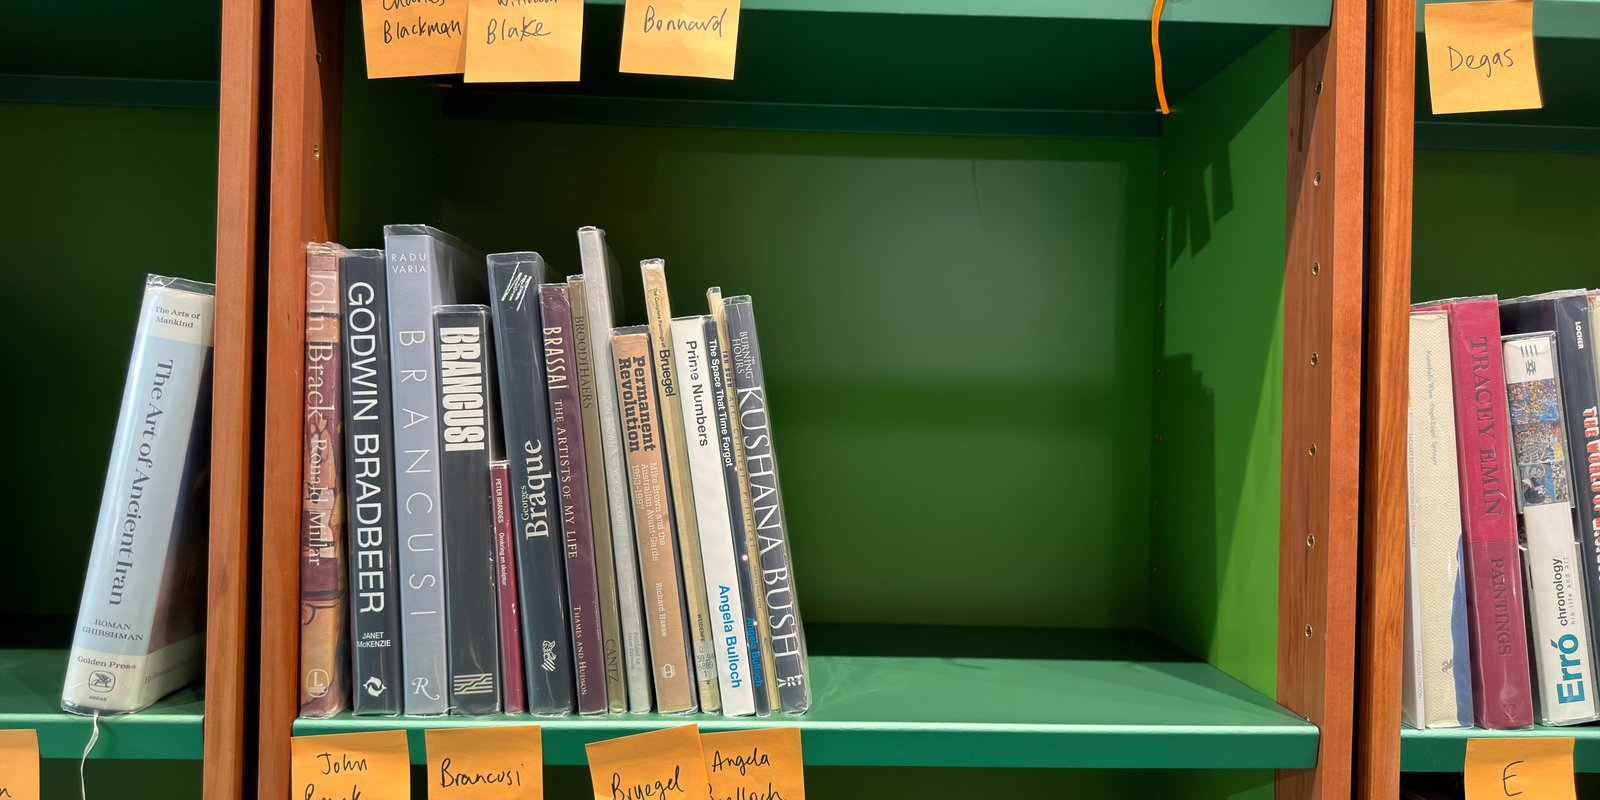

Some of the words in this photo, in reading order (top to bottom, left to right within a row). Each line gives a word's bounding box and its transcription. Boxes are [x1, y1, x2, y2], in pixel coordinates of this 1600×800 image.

[383, 16, 462, 44] Blackman
[487, 16, 552, 45] Blake
[1446, 45, 1514, 78] Degas
[391, 252, 427, 262] RADU
[391, 265, 427, 274] VARIA
[155, 306, 169, 315] The
[170, 309, 189, 318] Arts
[308, 269, 338, 331] John
[155, 316, 194, 329] Mankind
[1574, 321, 1584, 350] LOCHER
[348, 281, 379, 421] GODWIN
[543, 326, 570, 390] BRASSAÏ
[575, 316, 593, 409] BROODTHAERS
[709, 339, 718, 357] The
[733, 338, 745, 374] HOURS
[739, 331, 754, 379] BURNING
[154, 358, 174, 401] The
[308, 341, 336, 420] Brack
[440, 326, 485, 452] BRANCUSI
[659, 349, 677, 397] Bruegel
[711, 357, 721, 388] Space
[1471, 336, 1496, 440] TRACEY
[618, 357, 635, 453] Revolution
[633, 355, 657, 452] Permanent
[686, 340, 698, 381] Prime
[693, 384, 709, 447] Numbers
[716, 388, 726, 411] That
[145, 403, 165, 441] Art
[554, 399, 564, 422] THE
[719, 411, 728, 435] Time
[1582, 406, 1600, 438] THE
[137, 443, 154, 470] of
[557, 427, 571, 483] ARTISTS
[722, 436, 733, 467] Forgot
[399, 330, 438, 616] BRANCUSI
[495, 478, 503, 497] PETER
[641, 463, 652, 507] Australian
[651, 461, 659, 484] Mike
[1479, 445, 1503, 516] EMIN
[521, 485, 531, 520] Georges
[524, 439, 552, 540] Braque
[562, 485, 572, 499] OF
[652, 486, 662, 512] Brown
[119, 467, 150, 558] Ancient
[353, 433, 386, 614] BRADBEER
[496, 497, 505, 524] BRANDES
[564, 505, 575, 525] MY
[656, 514, 664, 529] and
[737, 386, 784, 556] KUSHANA
[762, 567, 803, 659] BUSH
[309, 511, 328, 567] Millar
[498, 532, 506, 557] Omkring
[566, 530, 578, 559] LIFE
[646, 510, 659, 562] Avant-Garde
[108, 560, 133, 605] Iran
[655, 582, 665, 613] Richard
[1552, 558, 1569, 626] chronology
[574, 605, 583, 639] THAMES
[718, 585, 734, 633] Angela
[1490, 558, 1511, 657] PAINTINGS
[82, 626, 144, 641] GHIRSHMAN
[94, 619, 132, 630] ROMAN
[361, 631, 385, 640] JANET
[746, 617, 758, 649] Angela
[356, 640, 392, 648] McKENZIE
[577, 641, 585, 659] AND
[605, 638, 619, 683] CANTZ
[77, 655, 107, 668] Golden
[108, 661, 137, 670] Press
[579, 660, 588, 696] HUDSON
[725, 636, 742, 689] Bulloch
[751, 651, 763, 687] Bulloch
[1550, 633, 1585, 705] Erró
[412, 676, 441, 700] R
[316, 752, 368, 775] John
[440, 757, 525, 788] Brancusi
[712, 747, 771, 776] Angela
[1502, 760, 1524, 797] E
